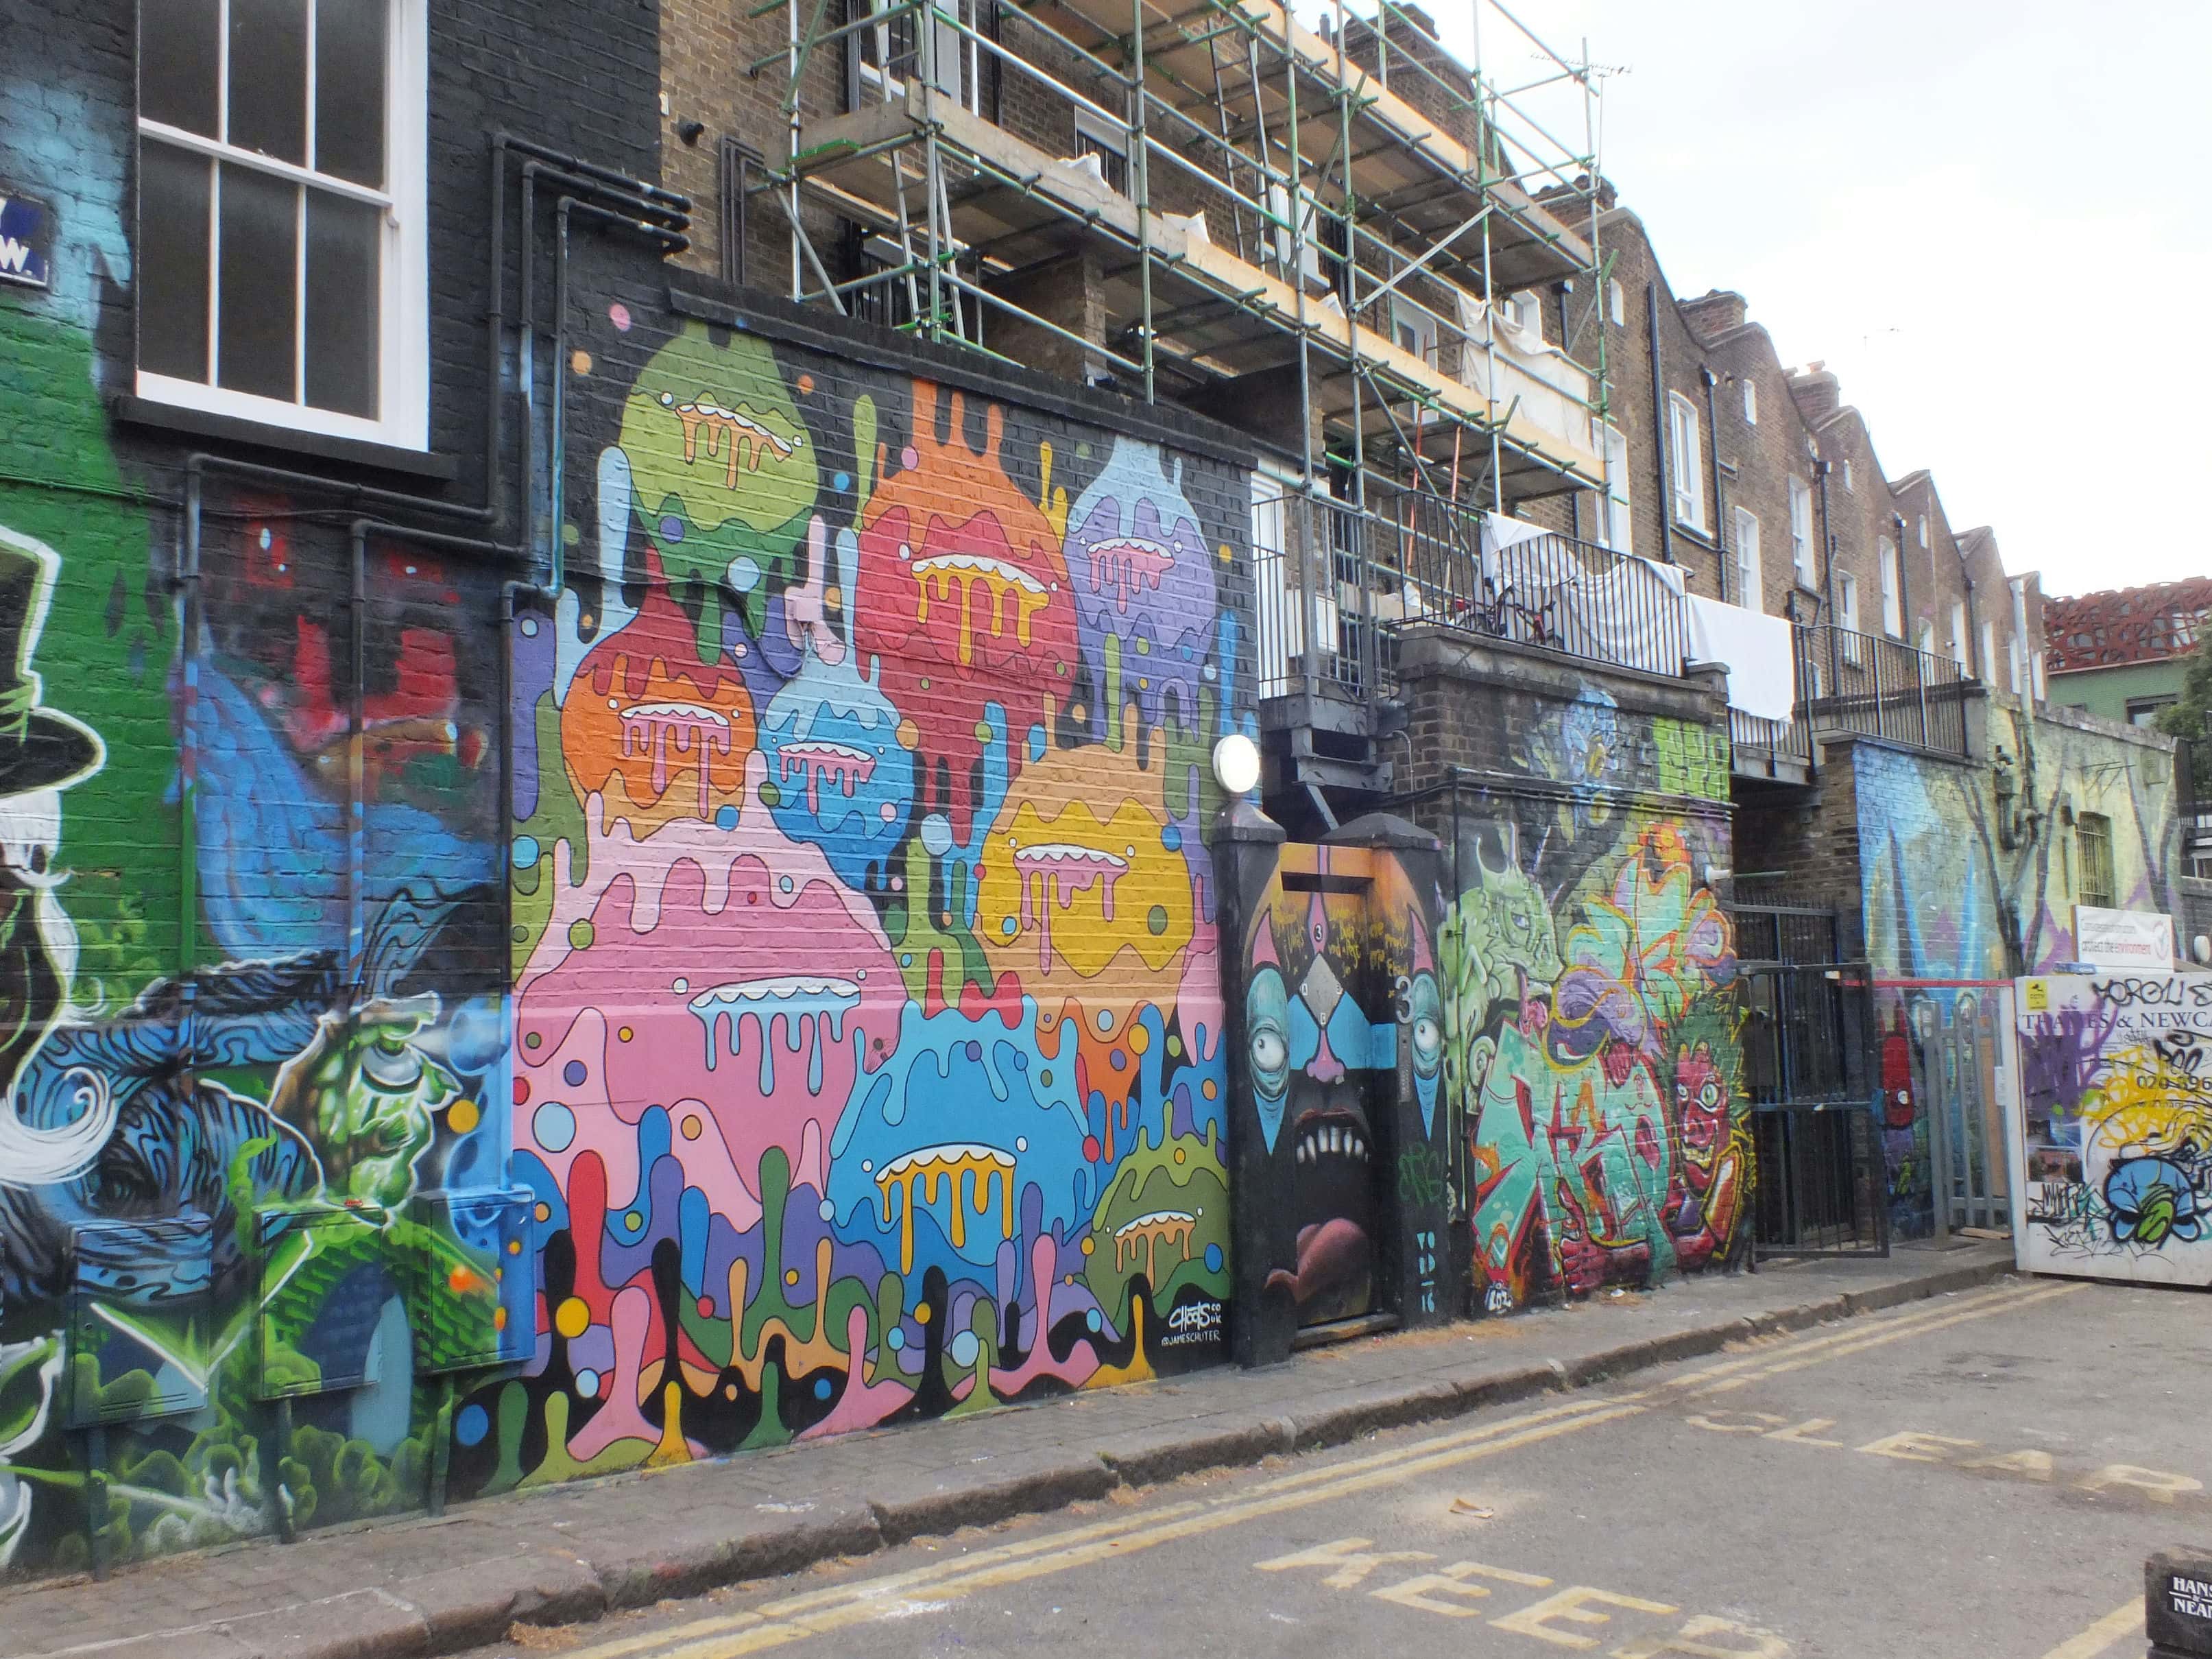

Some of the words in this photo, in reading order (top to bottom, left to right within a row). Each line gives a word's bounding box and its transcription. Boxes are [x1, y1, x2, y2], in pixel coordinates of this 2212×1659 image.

[1315, 924, 1322, 940] 3
[2115, 940, 2151, 955] environment
[1395, 975, 1413, 1024] 3
[2025, 1013, 2109, 1029] THAES
[2117, 1015, 2133, 1028] &
[2140, 1012, 2212, 1028] NEWC
[1685, 1410, 2203, 1503] CLEAR
[1252, 1536, 1791, 1659] KEEP
